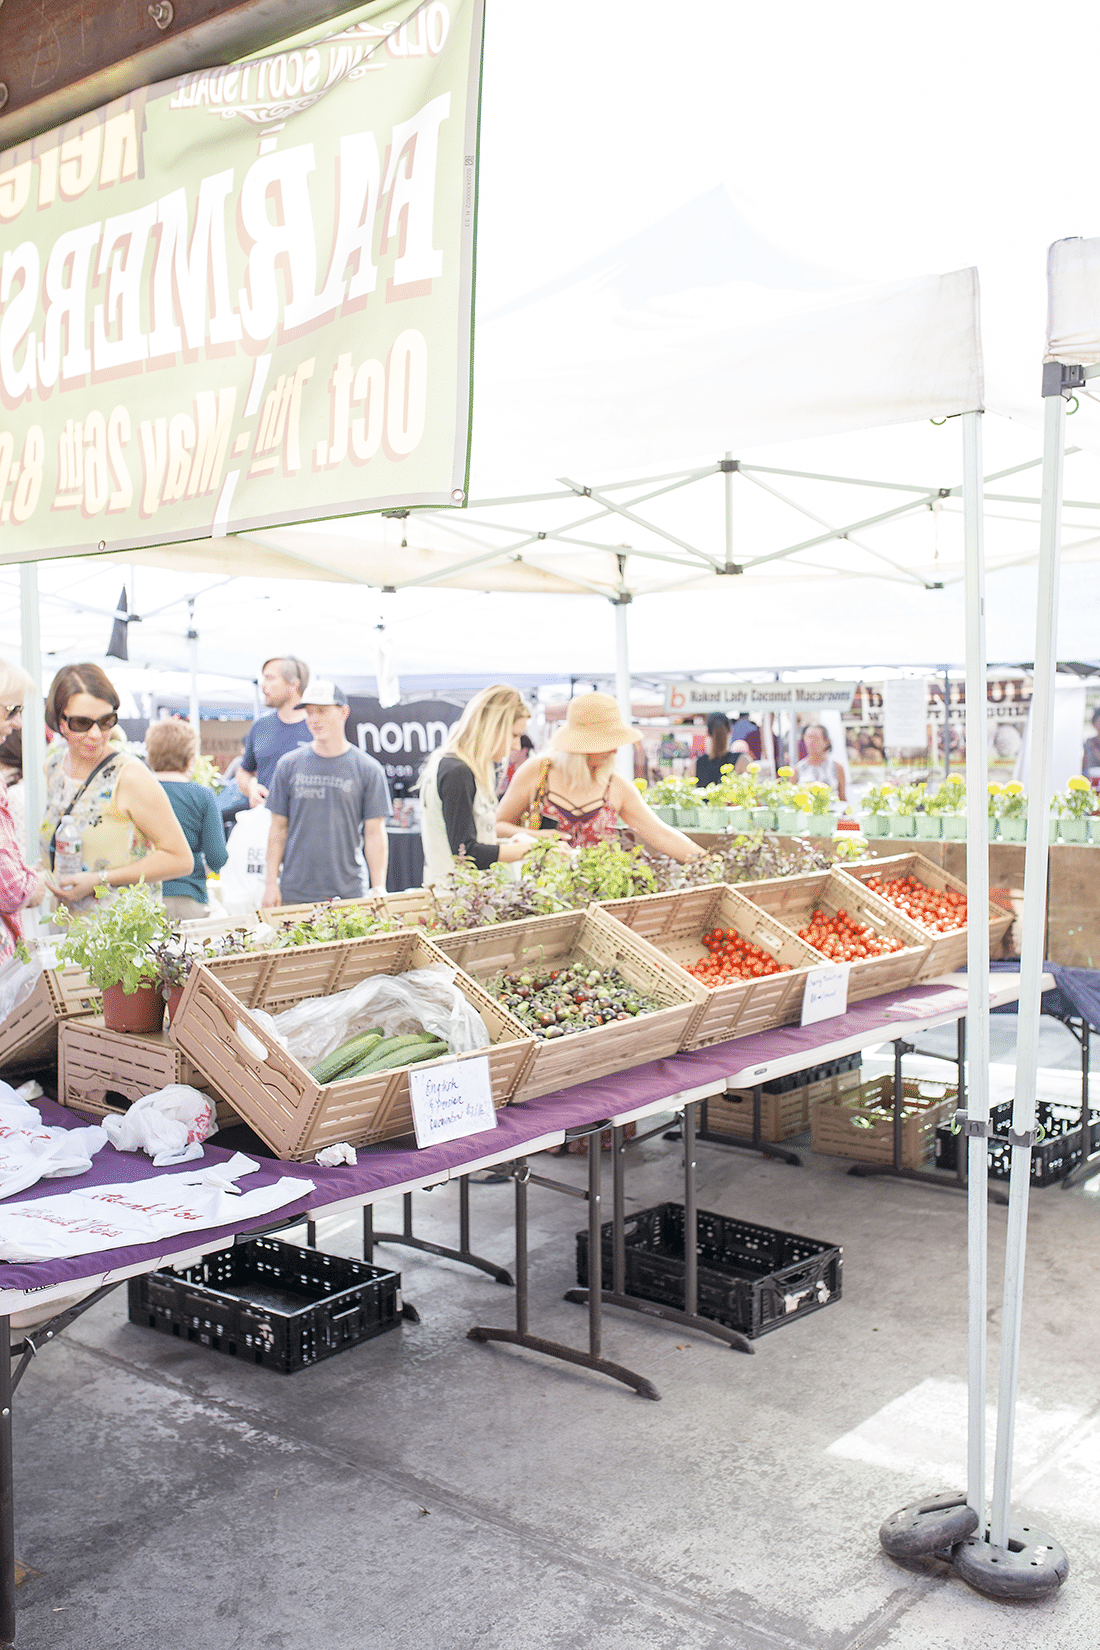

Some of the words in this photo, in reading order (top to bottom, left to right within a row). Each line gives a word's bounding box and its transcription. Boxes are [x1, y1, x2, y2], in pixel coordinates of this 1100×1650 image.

[690, 689, 721, 703] Naked
[725, 689, 747, 705] Lady
[751, 689, 792, 703] Coconut
[796, 688, 850, 703] Macaroons
[294, 773, 354, 793] Running
